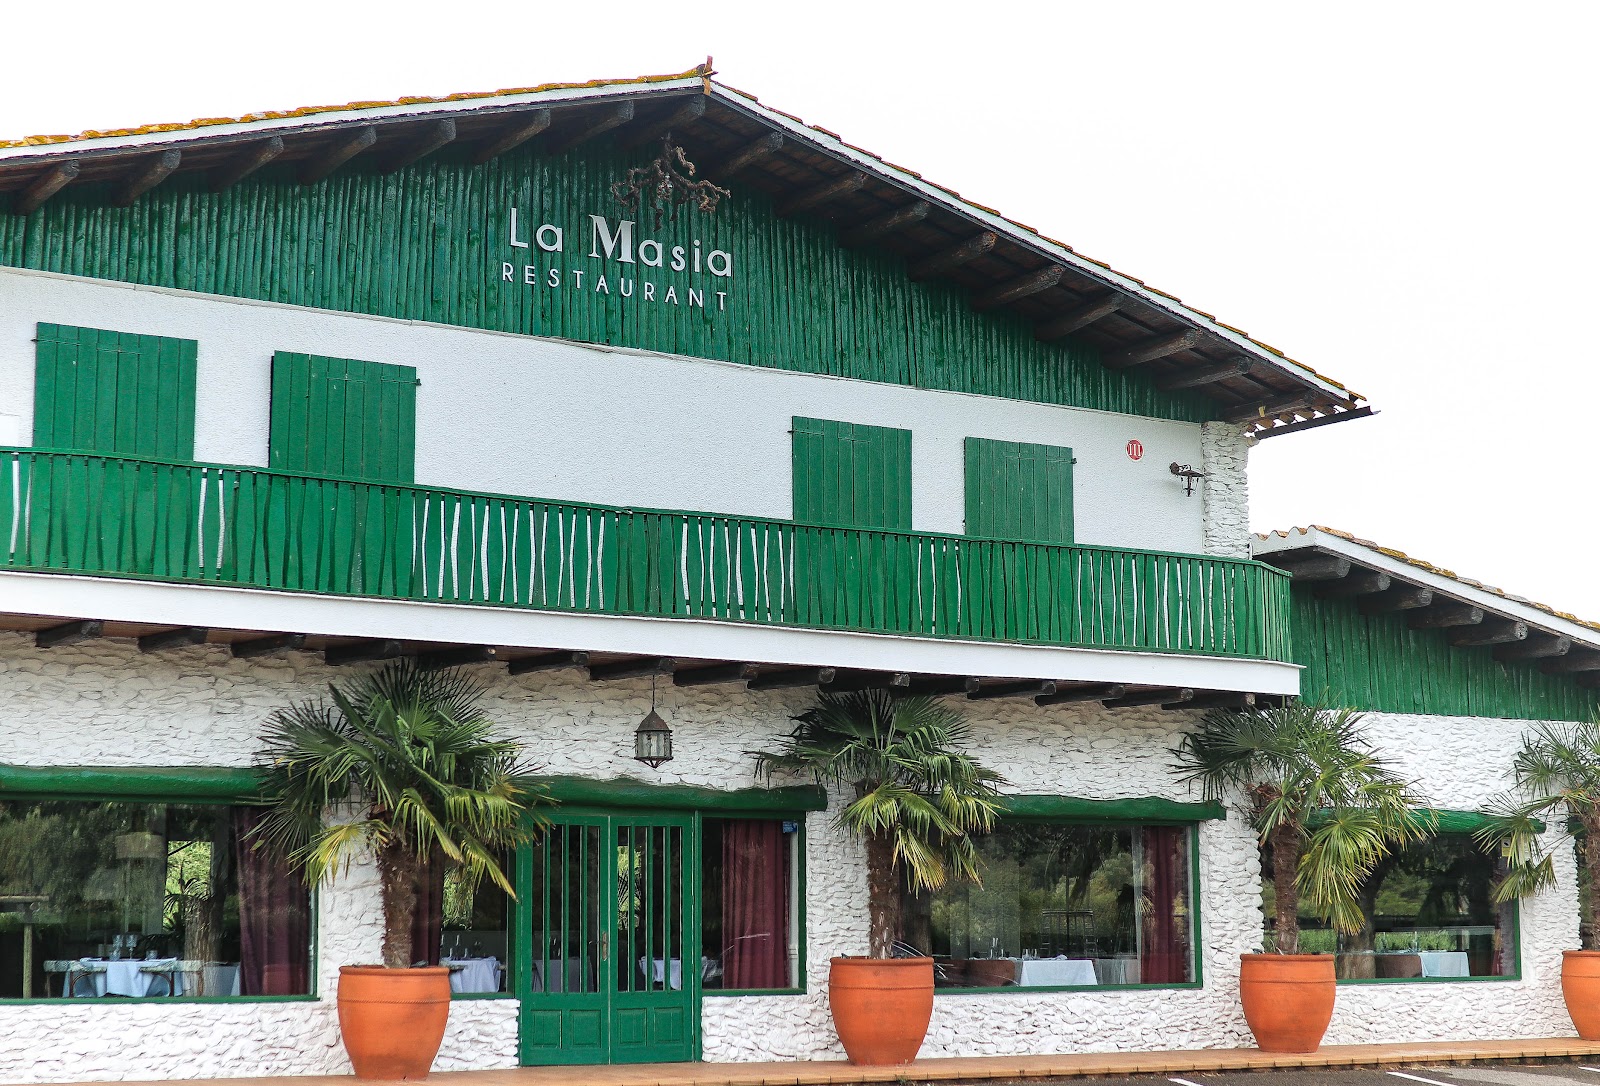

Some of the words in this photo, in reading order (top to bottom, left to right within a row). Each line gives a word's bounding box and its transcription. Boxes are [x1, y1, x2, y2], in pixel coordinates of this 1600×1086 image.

[510, 207, 563, 252] La
[588, 214, 732, 277] Masia
[502, 261, 727, 311] RESTAURANT
